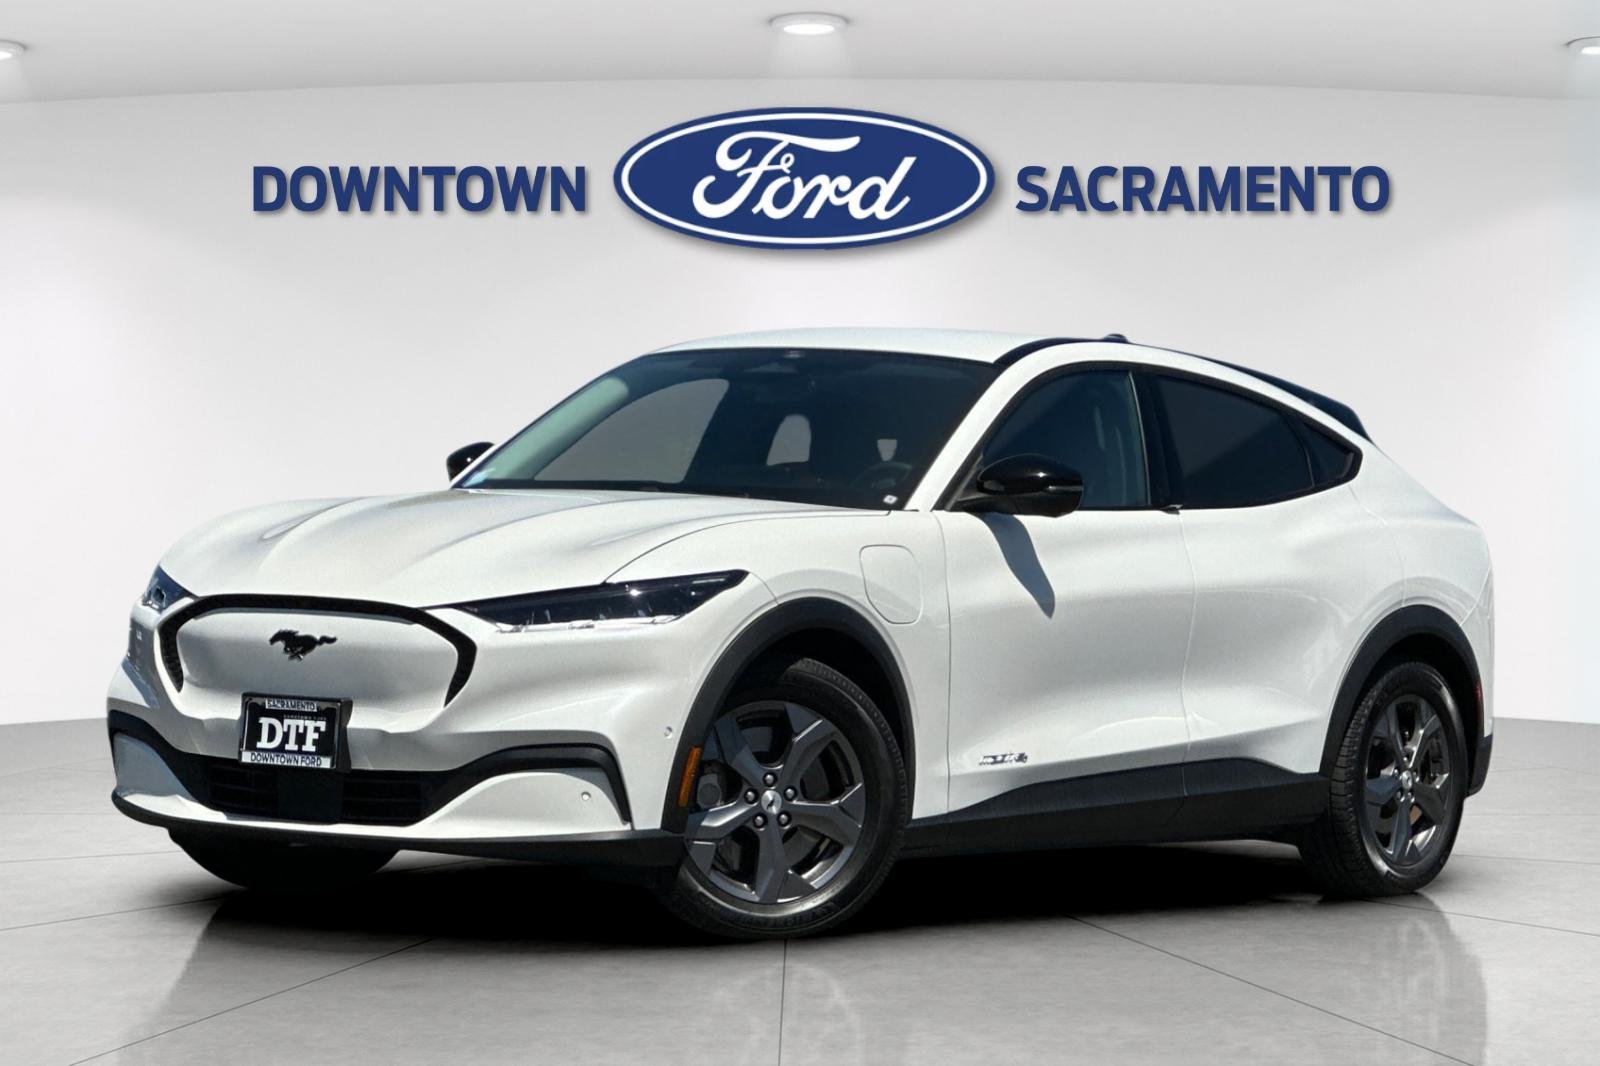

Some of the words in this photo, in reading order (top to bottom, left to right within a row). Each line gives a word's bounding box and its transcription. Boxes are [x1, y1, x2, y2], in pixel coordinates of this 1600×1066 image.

[252, 166, 586, 212] DOWNTOWN
[692, 131, 917, 220] Ford
[1016, 166, 1390, 212] SACRAMENTO
[267, 699, 315, 711] SACRAMENTO
[256, 717, 327, 752] DTF
[250, 753, 299, 765] DOWNTOWN
[301, 757, 322, 767] FORD
